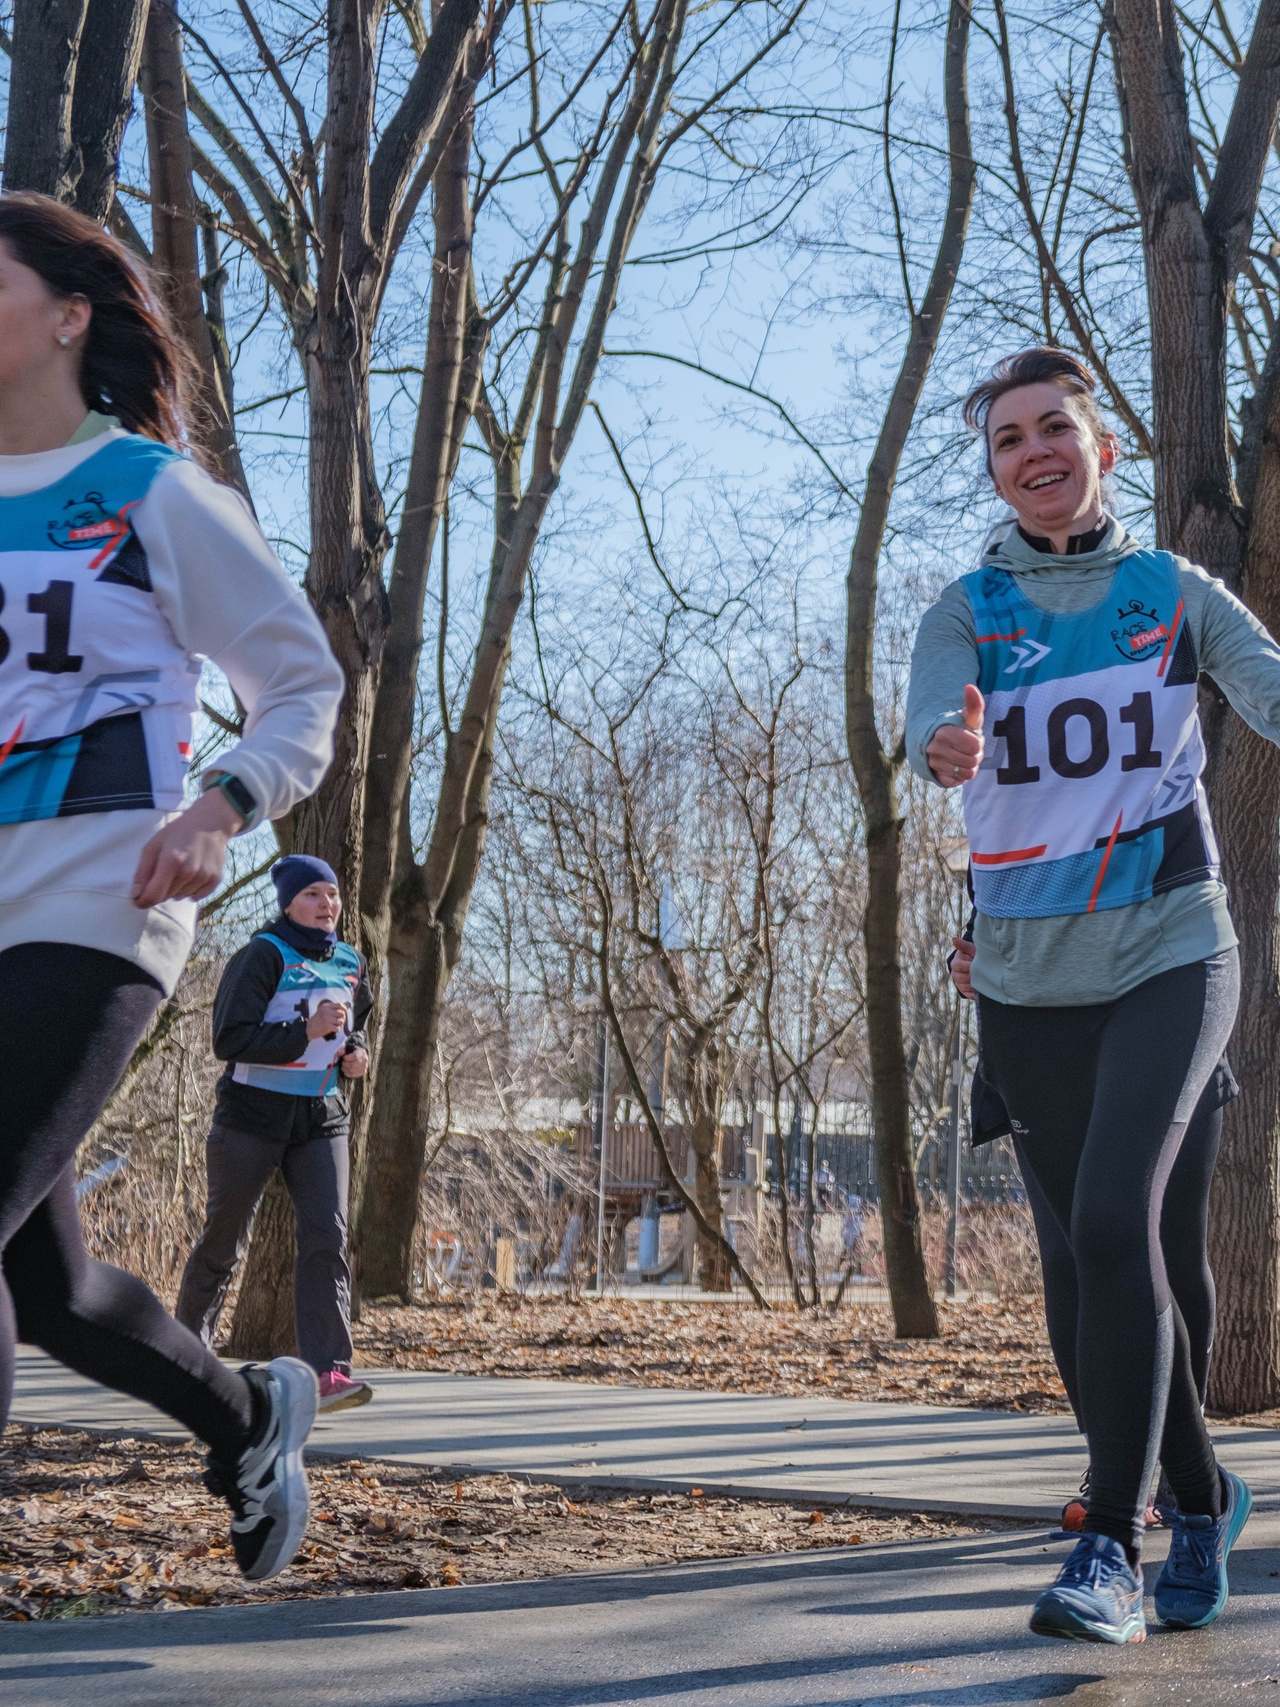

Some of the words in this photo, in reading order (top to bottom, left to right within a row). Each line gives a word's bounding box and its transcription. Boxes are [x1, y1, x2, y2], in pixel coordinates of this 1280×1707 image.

[0, 579, 84, 674] 1
[1110, 621, 1147, 641] RACE
[1133, 627, 1163, 647] TIME
[993, 691, 1162, 785] 101
